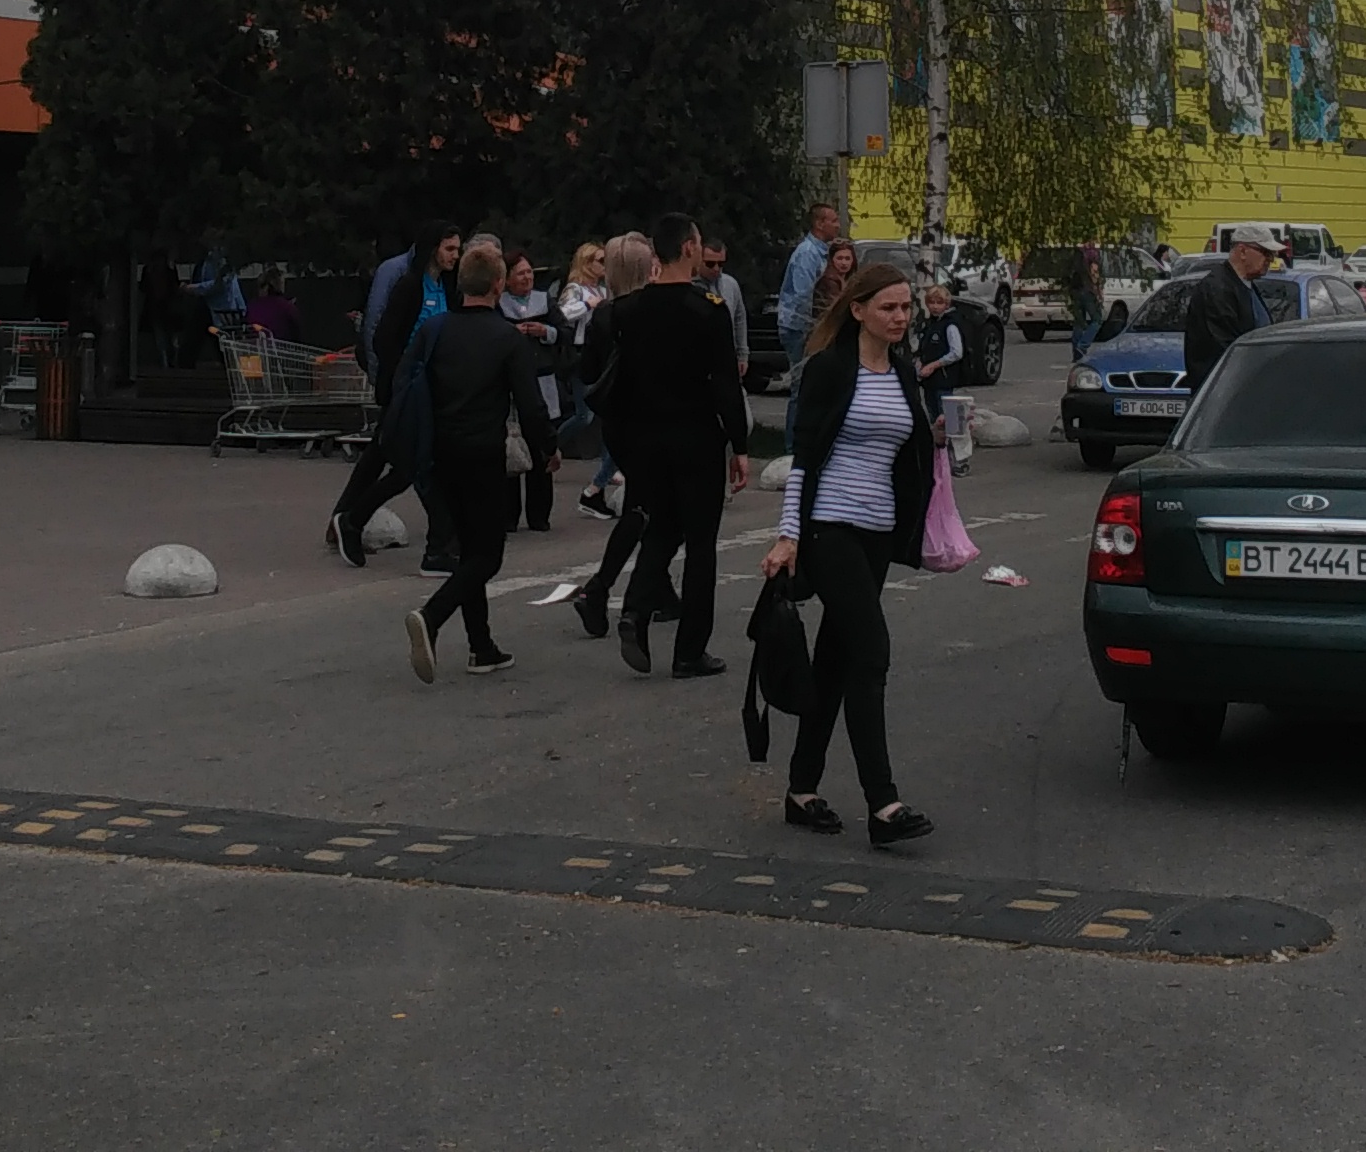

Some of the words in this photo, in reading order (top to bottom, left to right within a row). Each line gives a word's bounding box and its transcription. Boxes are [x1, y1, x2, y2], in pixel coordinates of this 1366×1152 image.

[1122, 402, 1137, 413] BT
[1140, 403, 1165, 414] 6004
[1167, 403, 1182, 415] BE
[1156, 501, 1184, 511] LADA
[1243, 546, 1281, 574] BT
[1288, 547, 1351, 576] 2444
